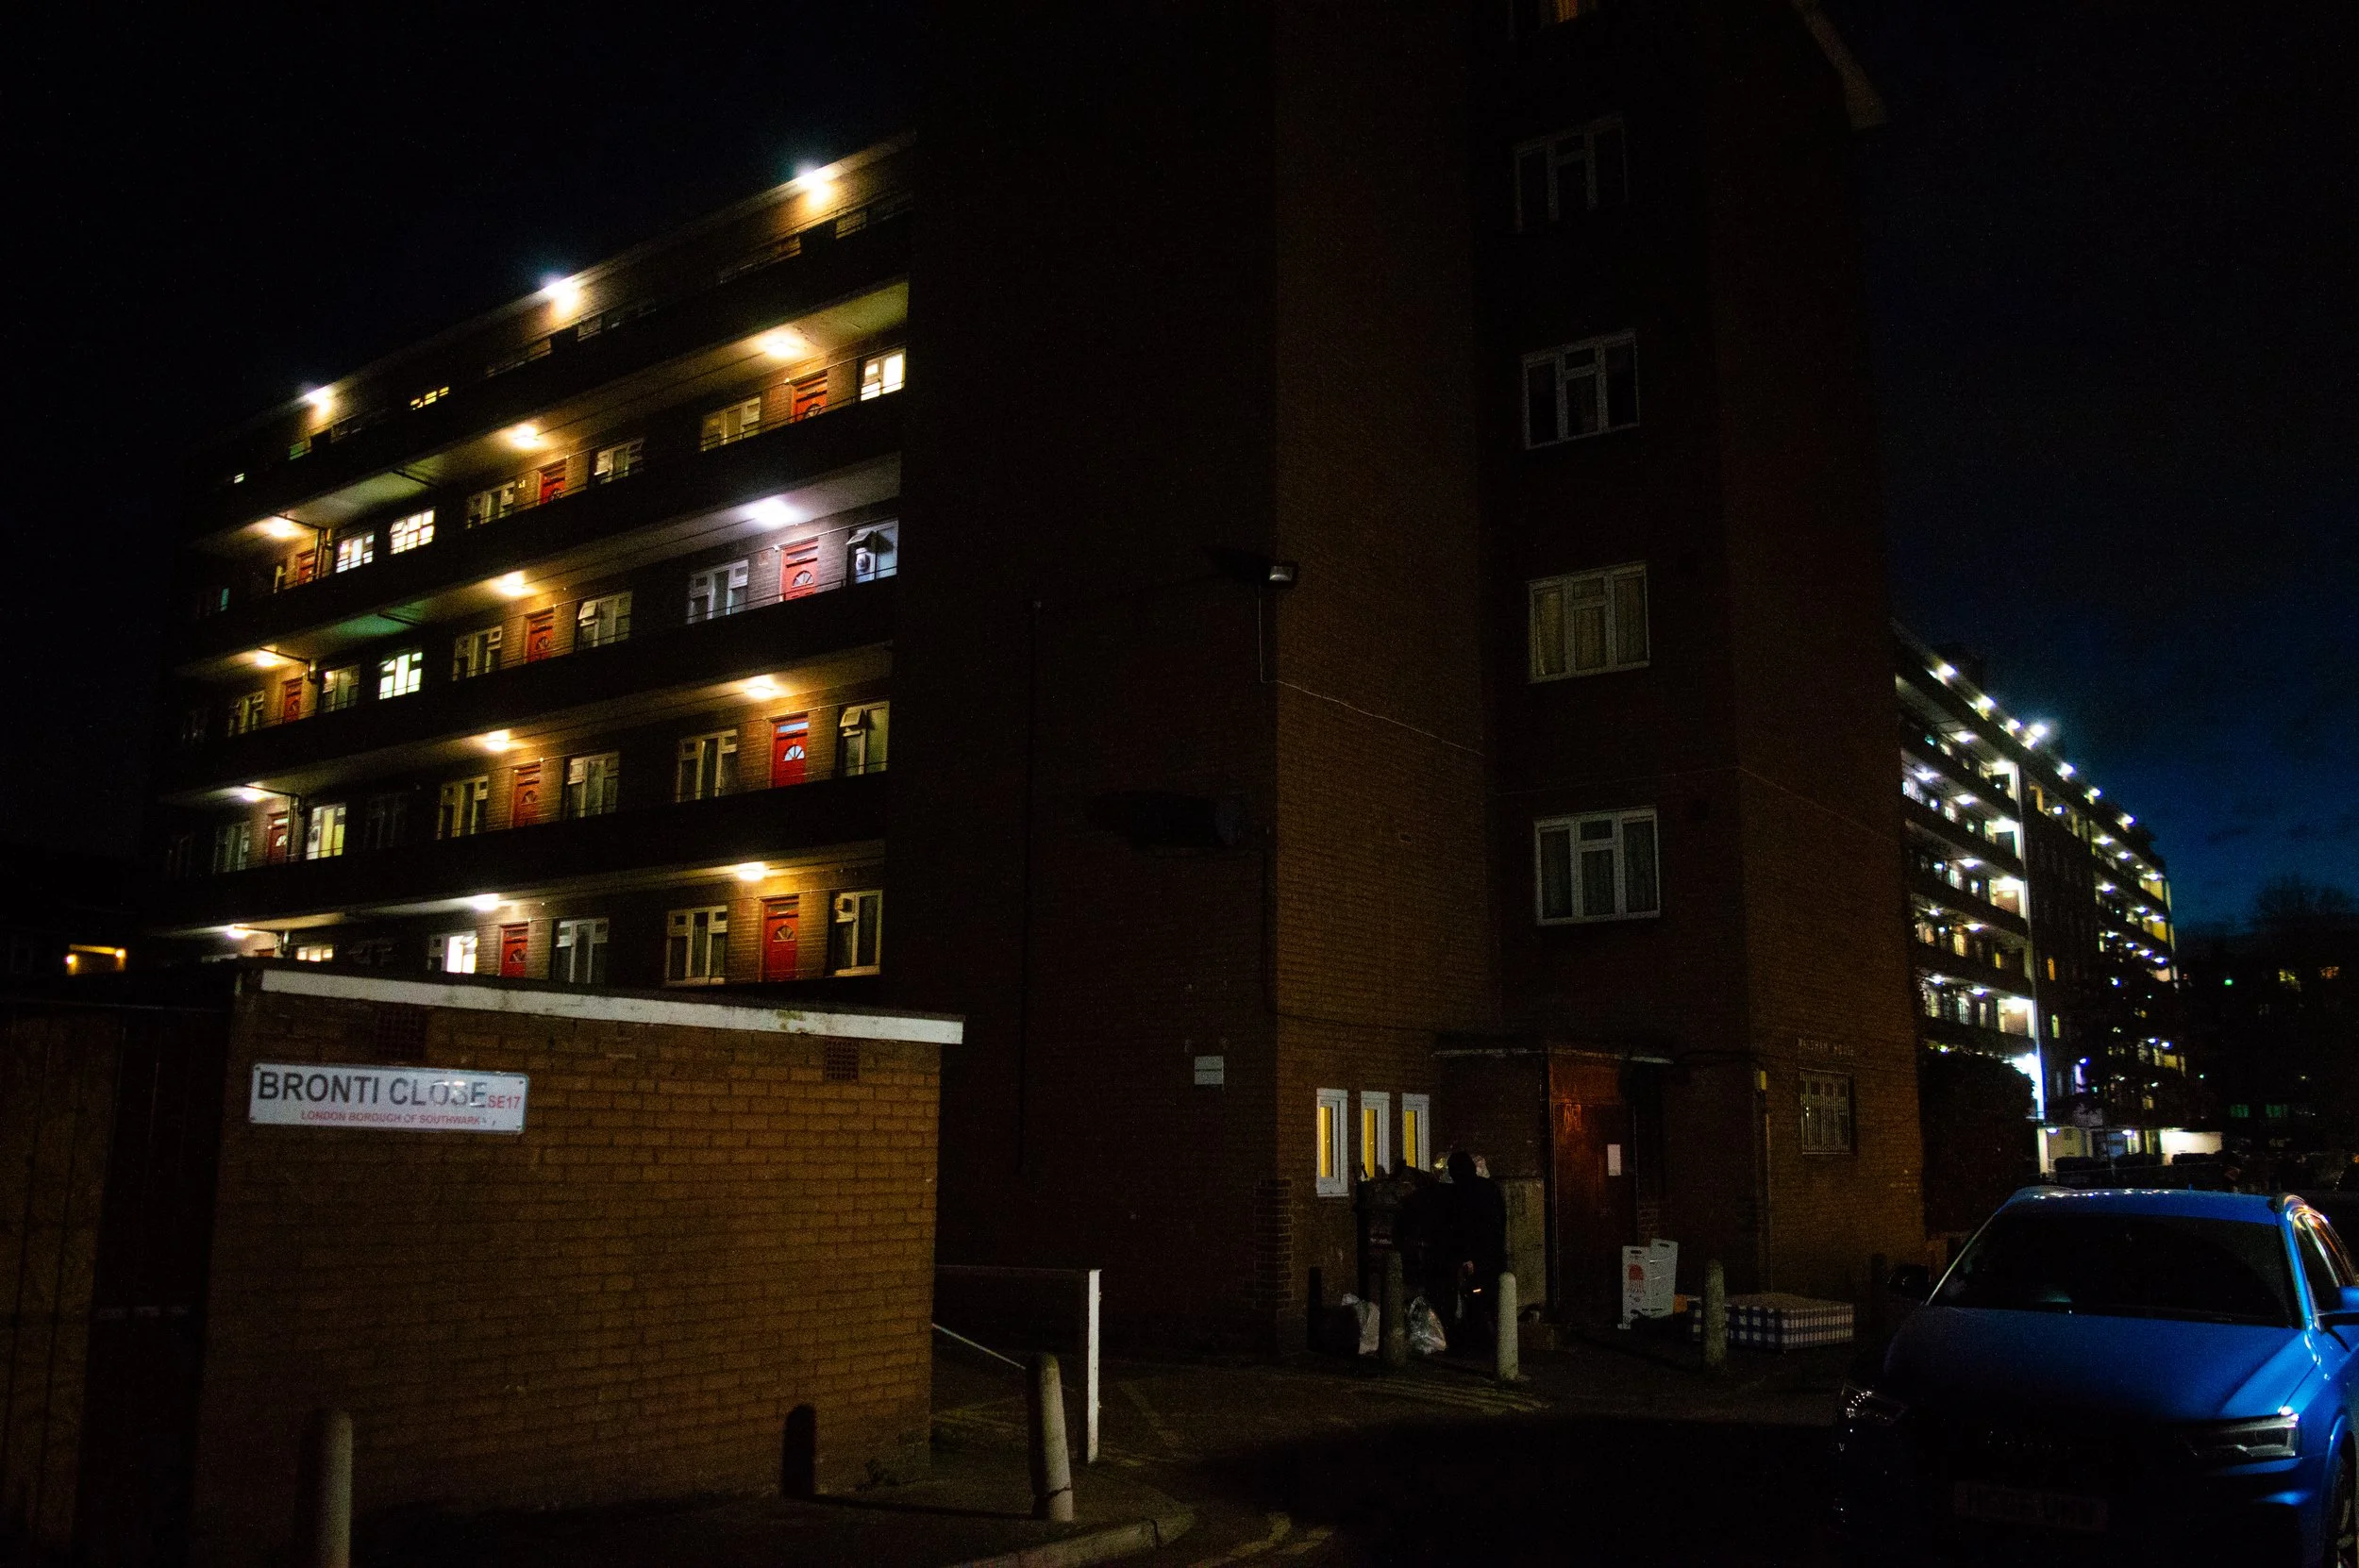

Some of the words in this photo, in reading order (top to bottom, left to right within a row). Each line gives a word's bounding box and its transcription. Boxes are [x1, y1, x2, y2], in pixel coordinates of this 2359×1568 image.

[258, 1071, 378, 1104] BRONTI
[389, 1077, 487, 1108] CLOSE
[487, 1094, 522, 1109] SE17
[301, 1110, 346, 1121] LONDON
[348, 1111, 401, 1123] BOROUGH
[403, 1113, 417, 1124] OF
[419, 1114, 480, 1126] SOUTHWARK
